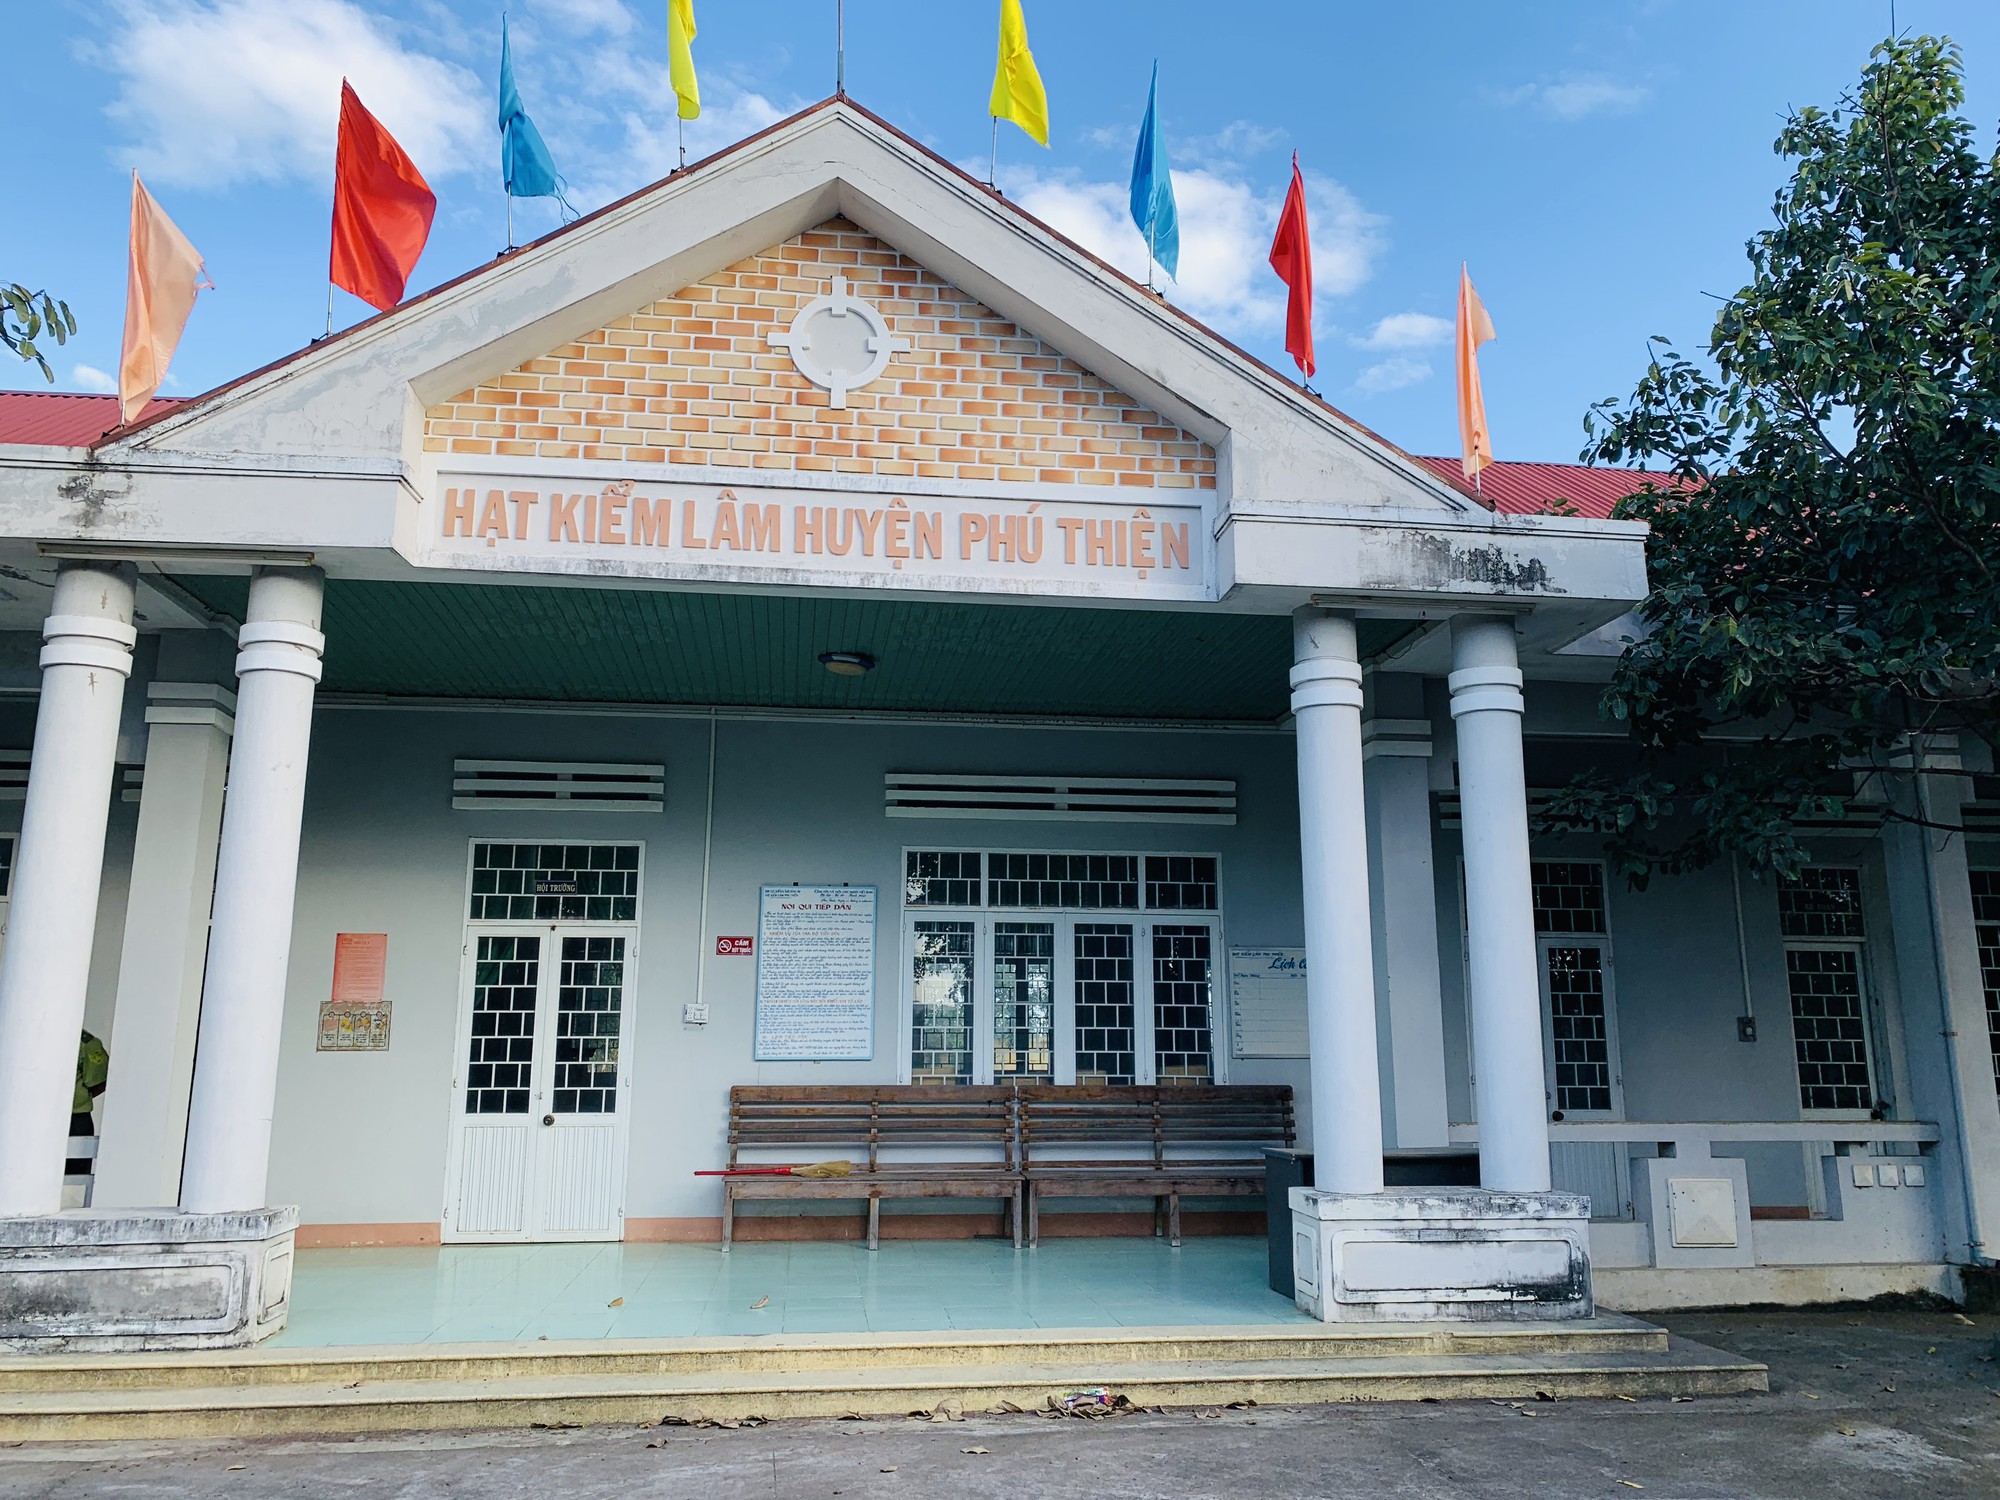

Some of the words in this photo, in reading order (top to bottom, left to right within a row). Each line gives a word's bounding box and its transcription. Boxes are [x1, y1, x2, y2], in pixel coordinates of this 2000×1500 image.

[443, 488, 538, 547] HẠT
[549, 480, 672, 547] KIỂM
[681, 489, 782, 553] LÂM
[795, 497, 942, 569] HUYỆN
[960, 503, 1043, 563] PHÚ
[1057, 508, 1190, 579] THIỆN
[536, 883, 548, 893] HỘI
[1267, 957, 1295, 971] Lịch
